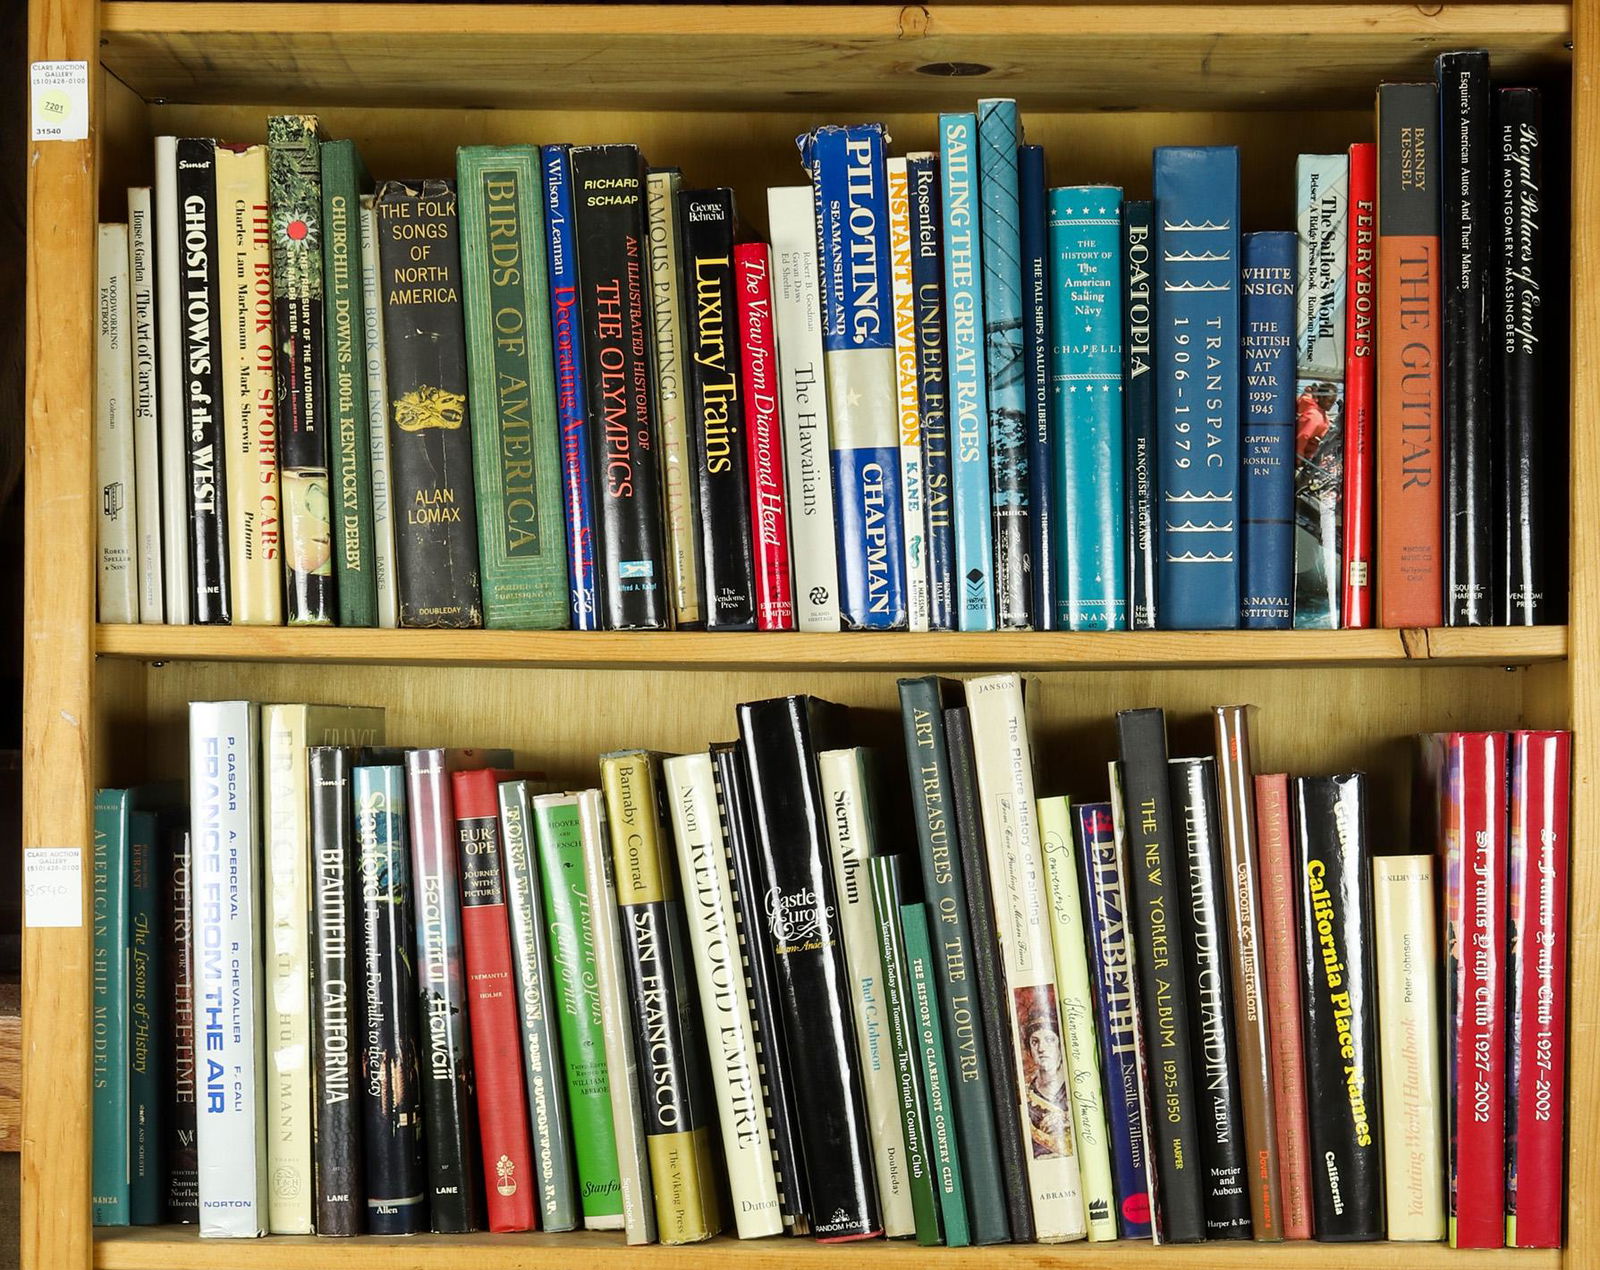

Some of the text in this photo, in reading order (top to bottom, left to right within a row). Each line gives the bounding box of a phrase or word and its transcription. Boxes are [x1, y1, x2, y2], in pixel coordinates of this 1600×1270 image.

[45, 101, 64, 111] 7201
[1400, 127, 1413, 191] KESSEL
[1412, 127, 1426, 191] BARNEY
[379, 201, 456, 219] THE FOLK
[391, 223, 448, 240] SONGS
[486, 179, 520, 287] BIRDS
[549, 158, 566, 276] Wilson/Leaman
[584, 177, 639, 190] RICHARD
[587, 195, 639, 207] SCHAAP
[689, 202, 722, 214] George
[689, 211, 725, 222] Behrend
[846, 135, 880, 345] PILOTING,
[916, 170, 937, 258] Rosenfeld
[1502, 125, 1515, 354] HUGH MONTGOMERY-MASSINGBERD
[389, 288, 458, 306] AMERICA
[394, 266, 449, 283] NORTH
[409, 245, 431, 262] OF
[889, 171, 918, 447] INSTANT NAVIGATION
[945, 123, 981, 463] SAILING THE GREAT RACES
[1129, 224, 1151, 380] BOATOPIA
[1317, 195, 1338, 339] The Sailor's World
[1353, 199, 1374, 358] FERRYBOATS
[101, 288, 111, 337] FACTBOOK
[109, 275, 119, 350] WOODWORKING
[136, 289, 155, 418] The Art of Carving
[184, 195, 216, 514] GHOST TOWNS of the WEST
[497, 307, 525, 357] OF
[693, 255, 738, 474] Luxury Trains
[109, 398, 118, 430] Coleman
[252, 202, 279, 561] THE BOOK OF SPORTS CARS
[596, 280, 633, 499] THE OLYMPICS
[744, 258, 781, 546] The View from Diamond Head
[918, 283, 950, 537] UNDER FULL SAIL
[1205, 317, 1224, 470] TRANSPAC
[1398, 245, 1433, 494] THE GUITAR
[499, 371, 538, 551] AMERICA
[794, 361, 820, 516] The Hawaiians
[906, 461, 920, 512] KANE
[1136, 437, 1149, 551] FRANÇOISE LEGRAND
[407, 508, 462, 525] LOMAX
[415, 488, 455, 505] ALAN
[861, 462, 890, 615] CHAPMAN
[419, 606, 462, 616] DOUBLEDAY
[978, 681, 1015, 694] JANSON
[360, 791, 387, 904] Stanford
[617, 765, 647, 891] Barnaby Conrad
[832, 789, 863, 905] Sierra Album
[1044, 832, 1070, 925] Souvenirs
[912, 707, 979, 1083] ART TREASURES OF THE LOUVRE
[1089, 839, 1132, 1035] ELIZABETH
[93, 831, 109, 1090] AMERICAN SHIP MODELS
[319, 848, 349, 1105] BEAUTIFUL CALIFORNIA
[423, 874, 454, 1080] Beautiful Hawaii
[681, 784, 762, 1151] Nixon REDWOOD EMPIRE
[1140, 798, 1181, 1123] THE NEW YORKER ALBUM 1925-1950
[1306, 858, 1345, 990] California
[1327, 991, 1358, 1060] Place
[1343, 1065, 1374, 1148] Names
[634, 910, 680, 1127] SAN FRANCISCO
[1122, 1063, 1145, 1169] Neville Williams
[1171, 1138, 1184, 1170] HARPER
[203, 1200, 252, 1209] NORTON
[326, 1193, 349, 1202] LANE
[435, 1186, 458, 1195] LANE
[669, 1149, 686, 1234] The Viking Press
[1039, 1190, 1077, 1201] ABRAMS
[1323, 1151, 1345, 1216] California
